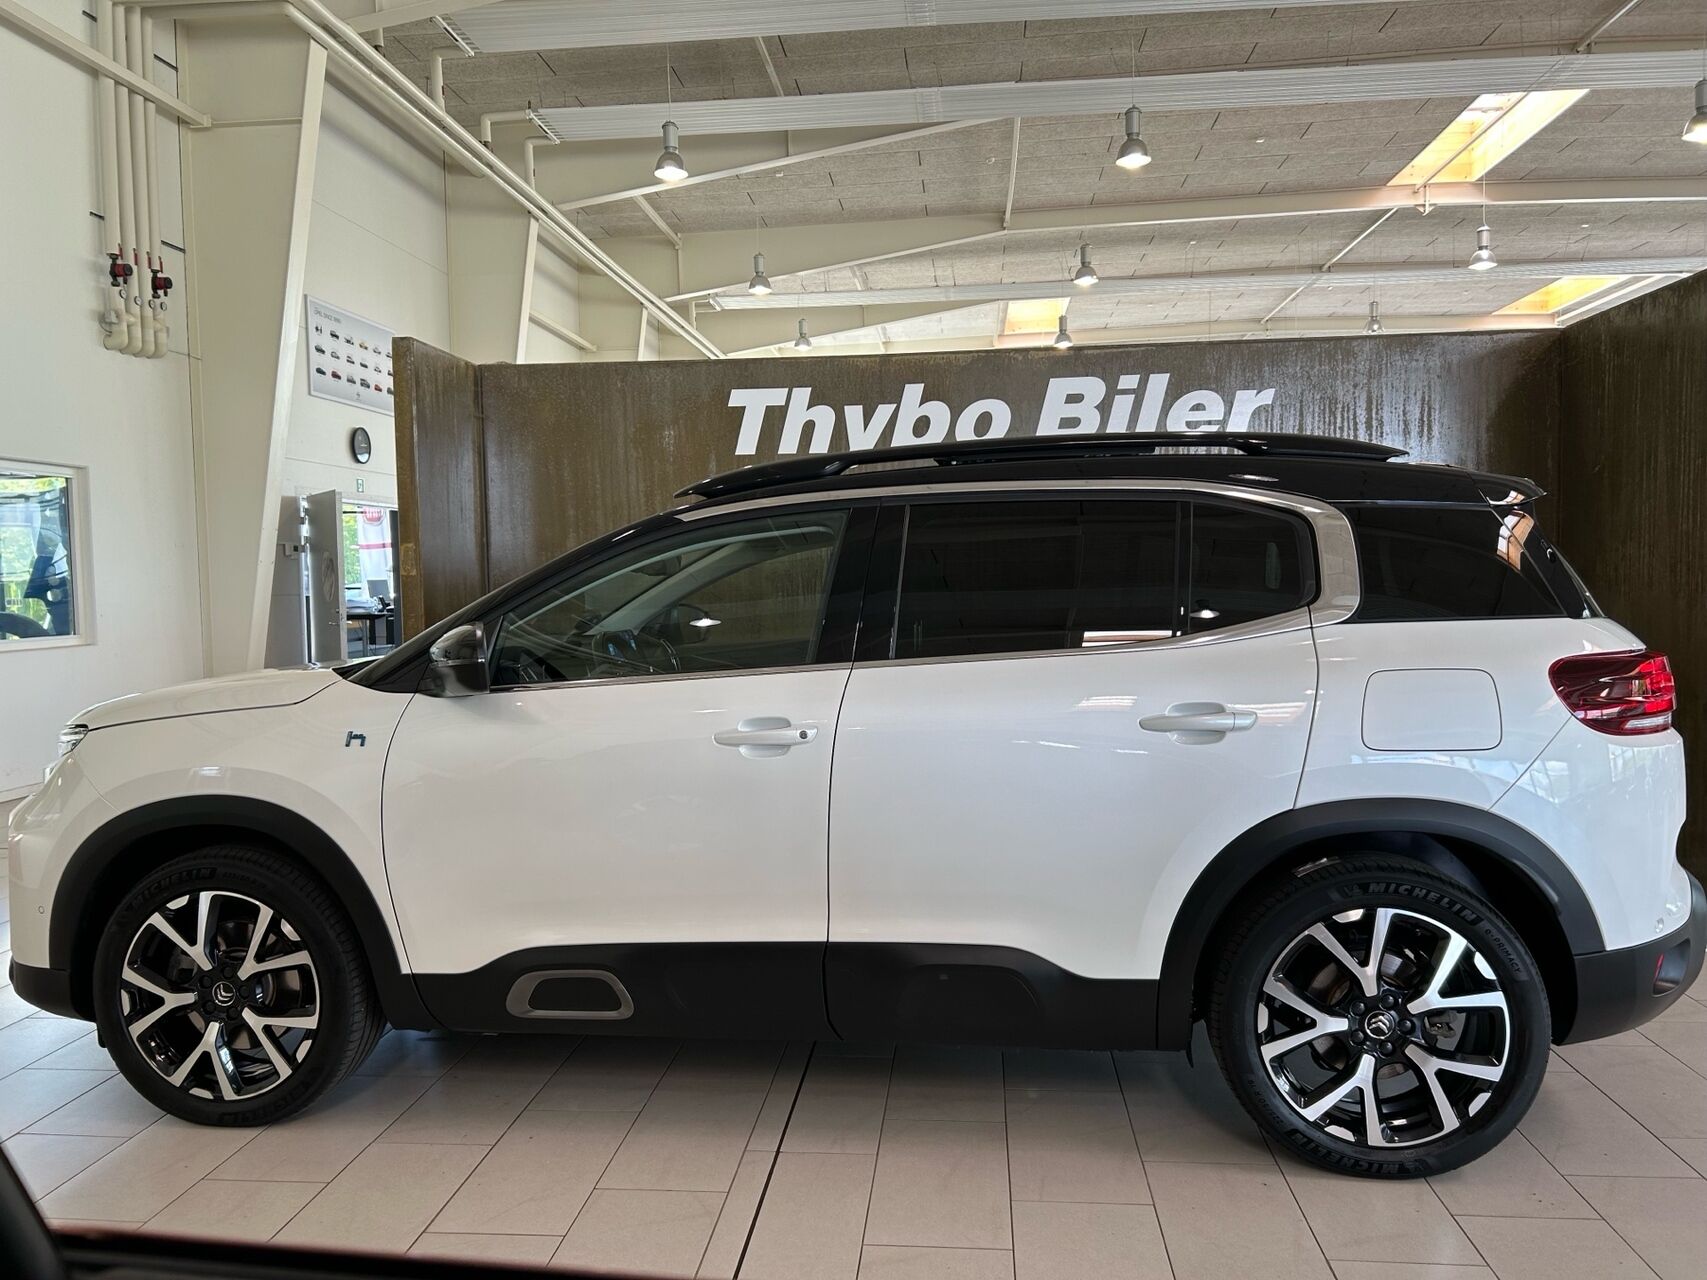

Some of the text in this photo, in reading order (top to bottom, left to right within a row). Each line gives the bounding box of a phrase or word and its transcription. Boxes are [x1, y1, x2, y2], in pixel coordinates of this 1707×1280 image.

[727, 372, 1276, 455] Thybo Biler
[1367, 882, 1479, 923] MICHELIN
[1289, 1131, 1400, 1175] MICHELIN
